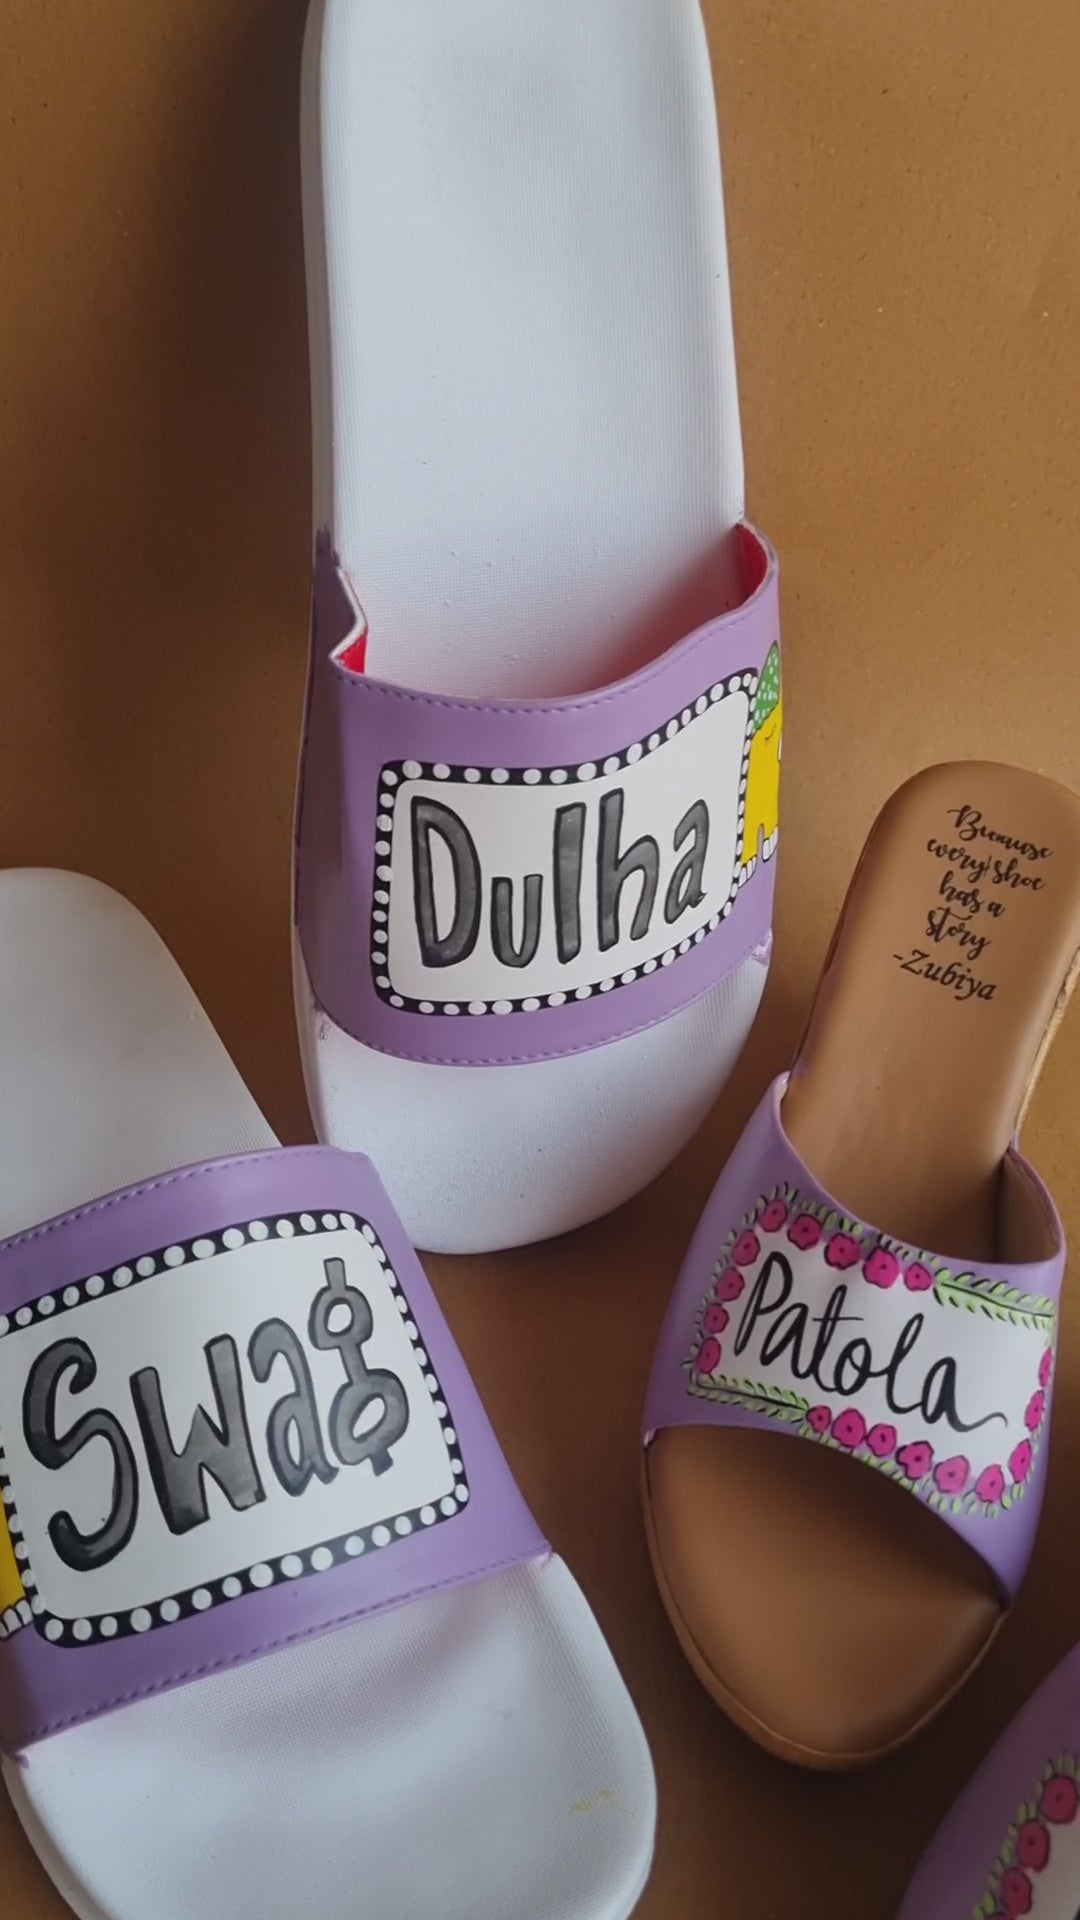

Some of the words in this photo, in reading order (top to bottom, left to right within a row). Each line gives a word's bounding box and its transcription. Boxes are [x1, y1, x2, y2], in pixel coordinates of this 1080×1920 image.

[410, 787, 710, 968] Dulha
[926, 838, 987, 884] every
[991, 857, 1046, 891] shoe
[938, 870, 985, 914] has
[986, 900, 1006, 918] a
[924, 906, 991, 961] story
[733, 1250, 1008, 1433] Patola
[21, 1256, 410, 1572] Swag
